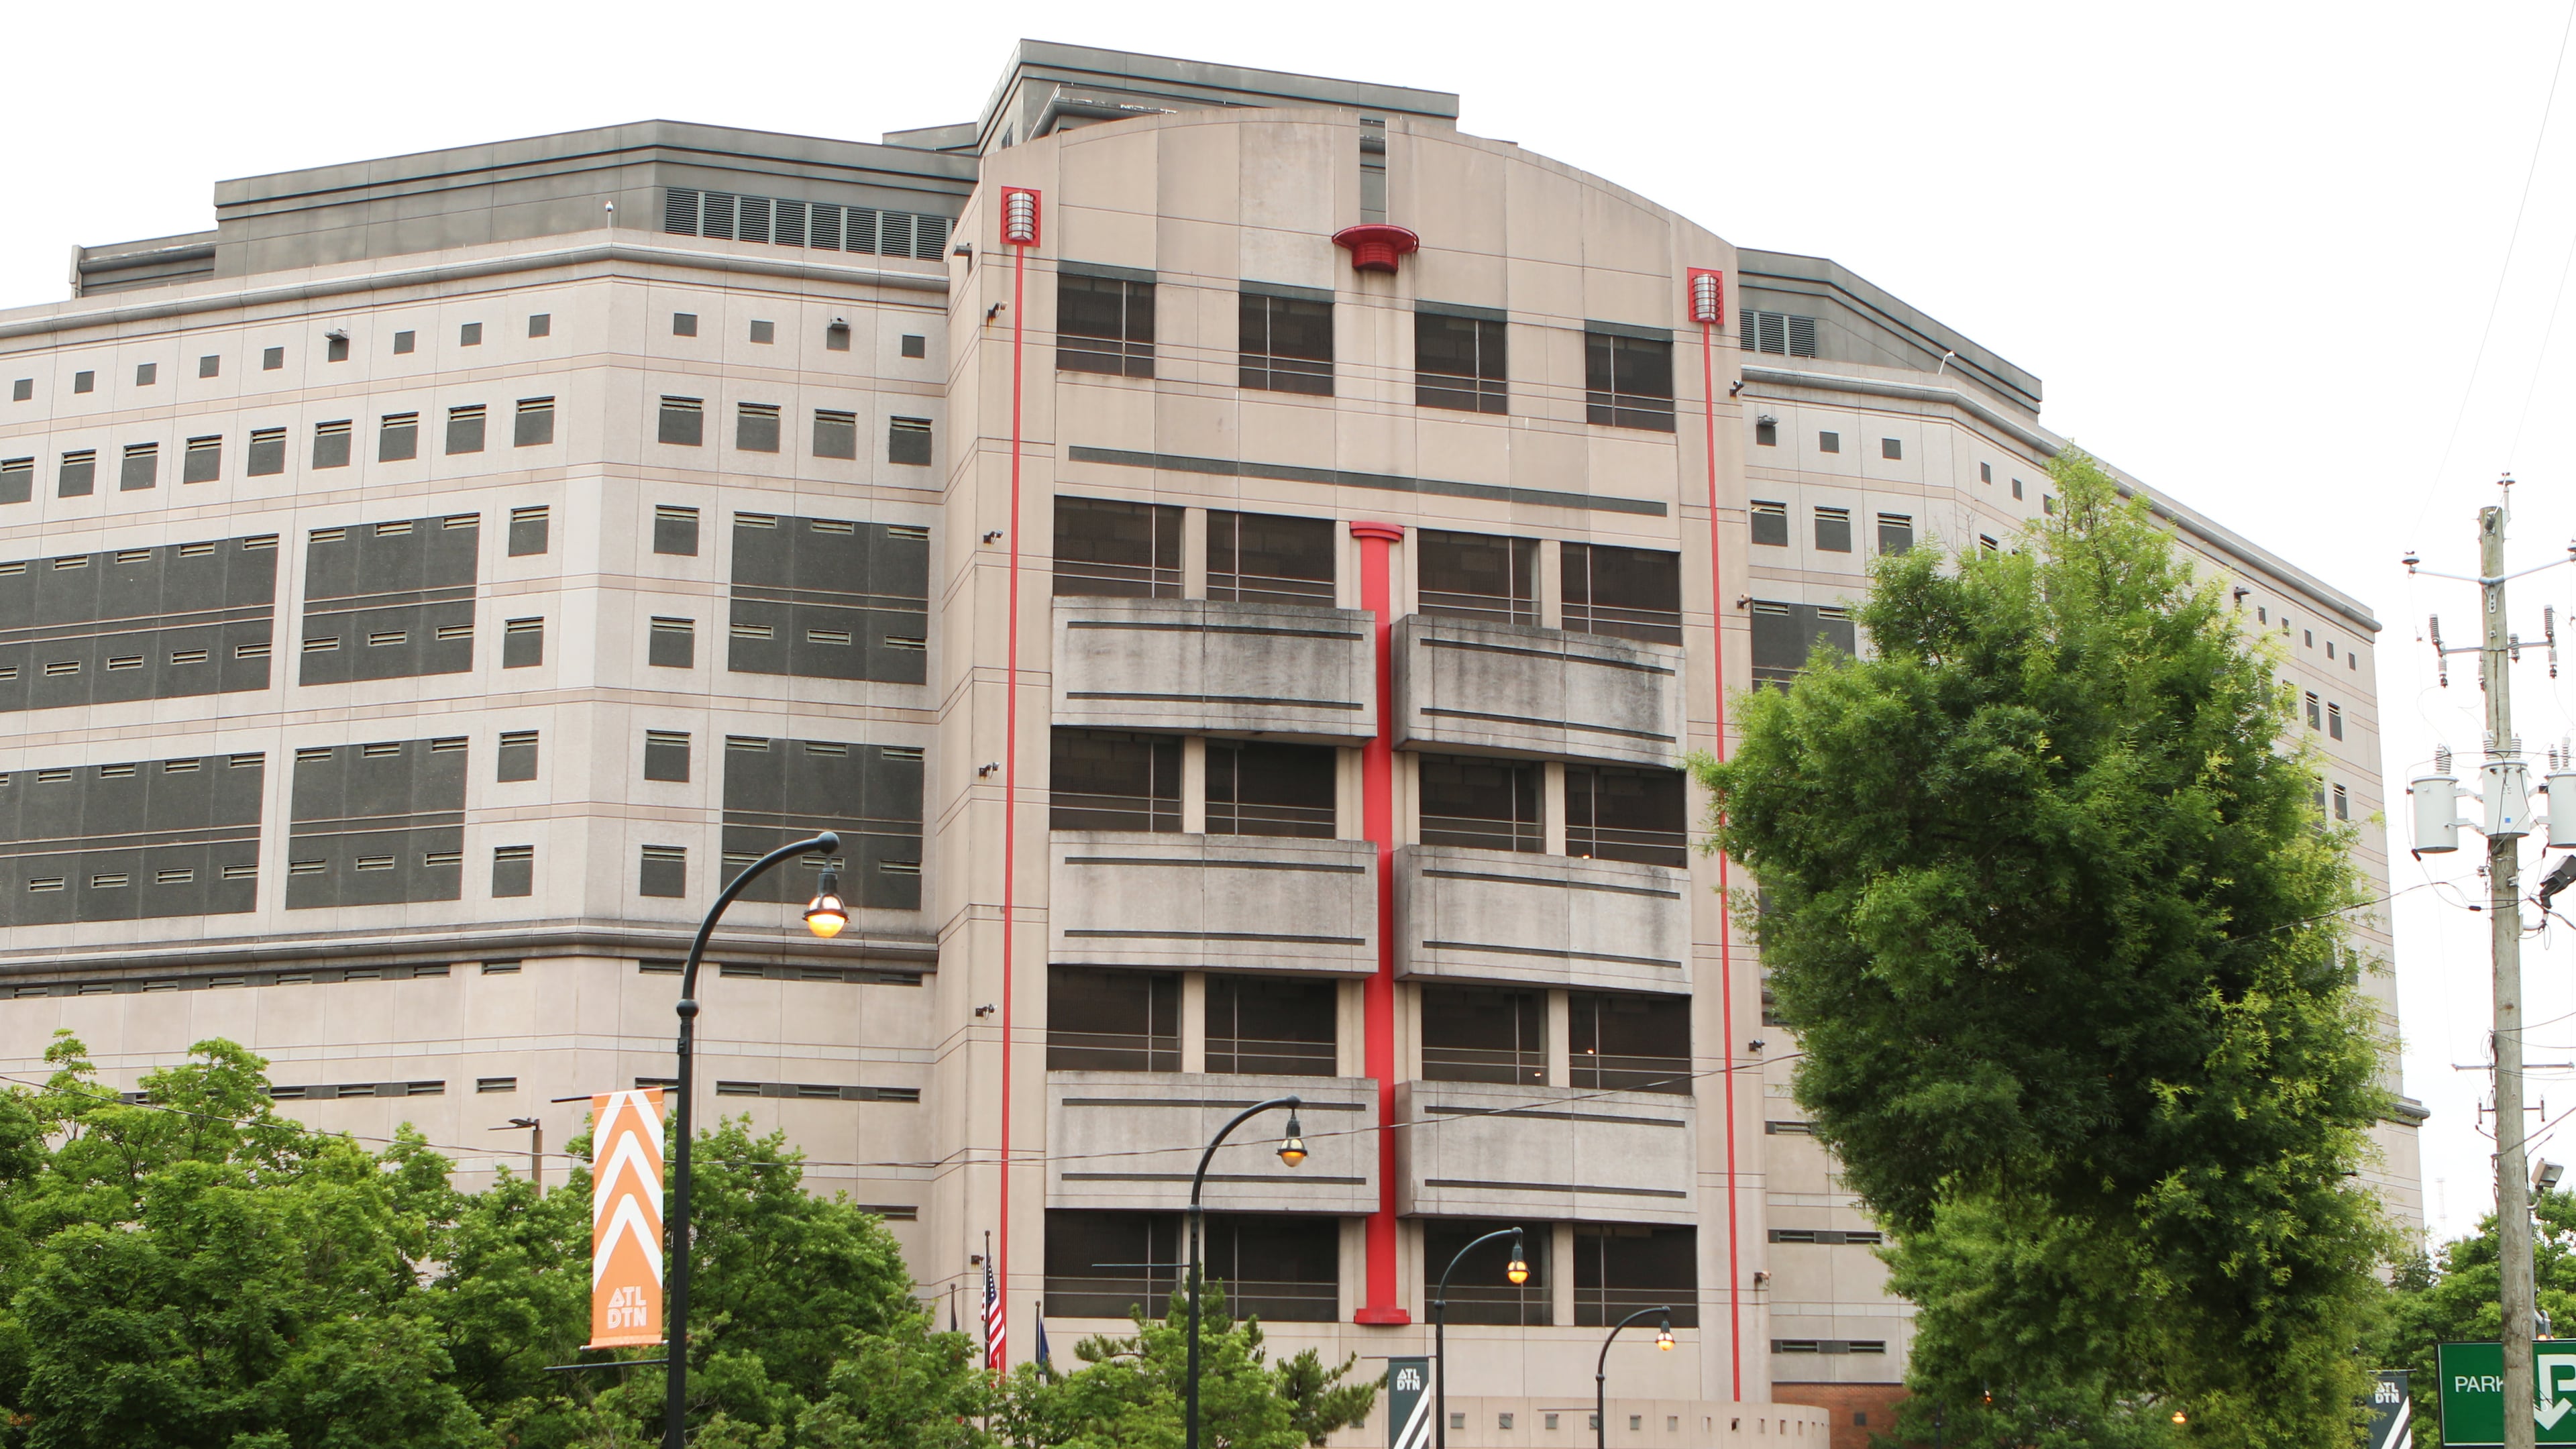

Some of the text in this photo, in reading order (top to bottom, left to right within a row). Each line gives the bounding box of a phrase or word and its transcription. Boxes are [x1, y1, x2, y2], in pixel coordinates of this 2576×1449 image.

[608, 1286, 647, 1308] ATL
[608, 1307, 647, 1329] DTN
[1397, 1368, 1420, 1379] ATL
[1397, 1379, 1420, 1391] DTN
[2375, 1393, 2400, 1403] DTN
